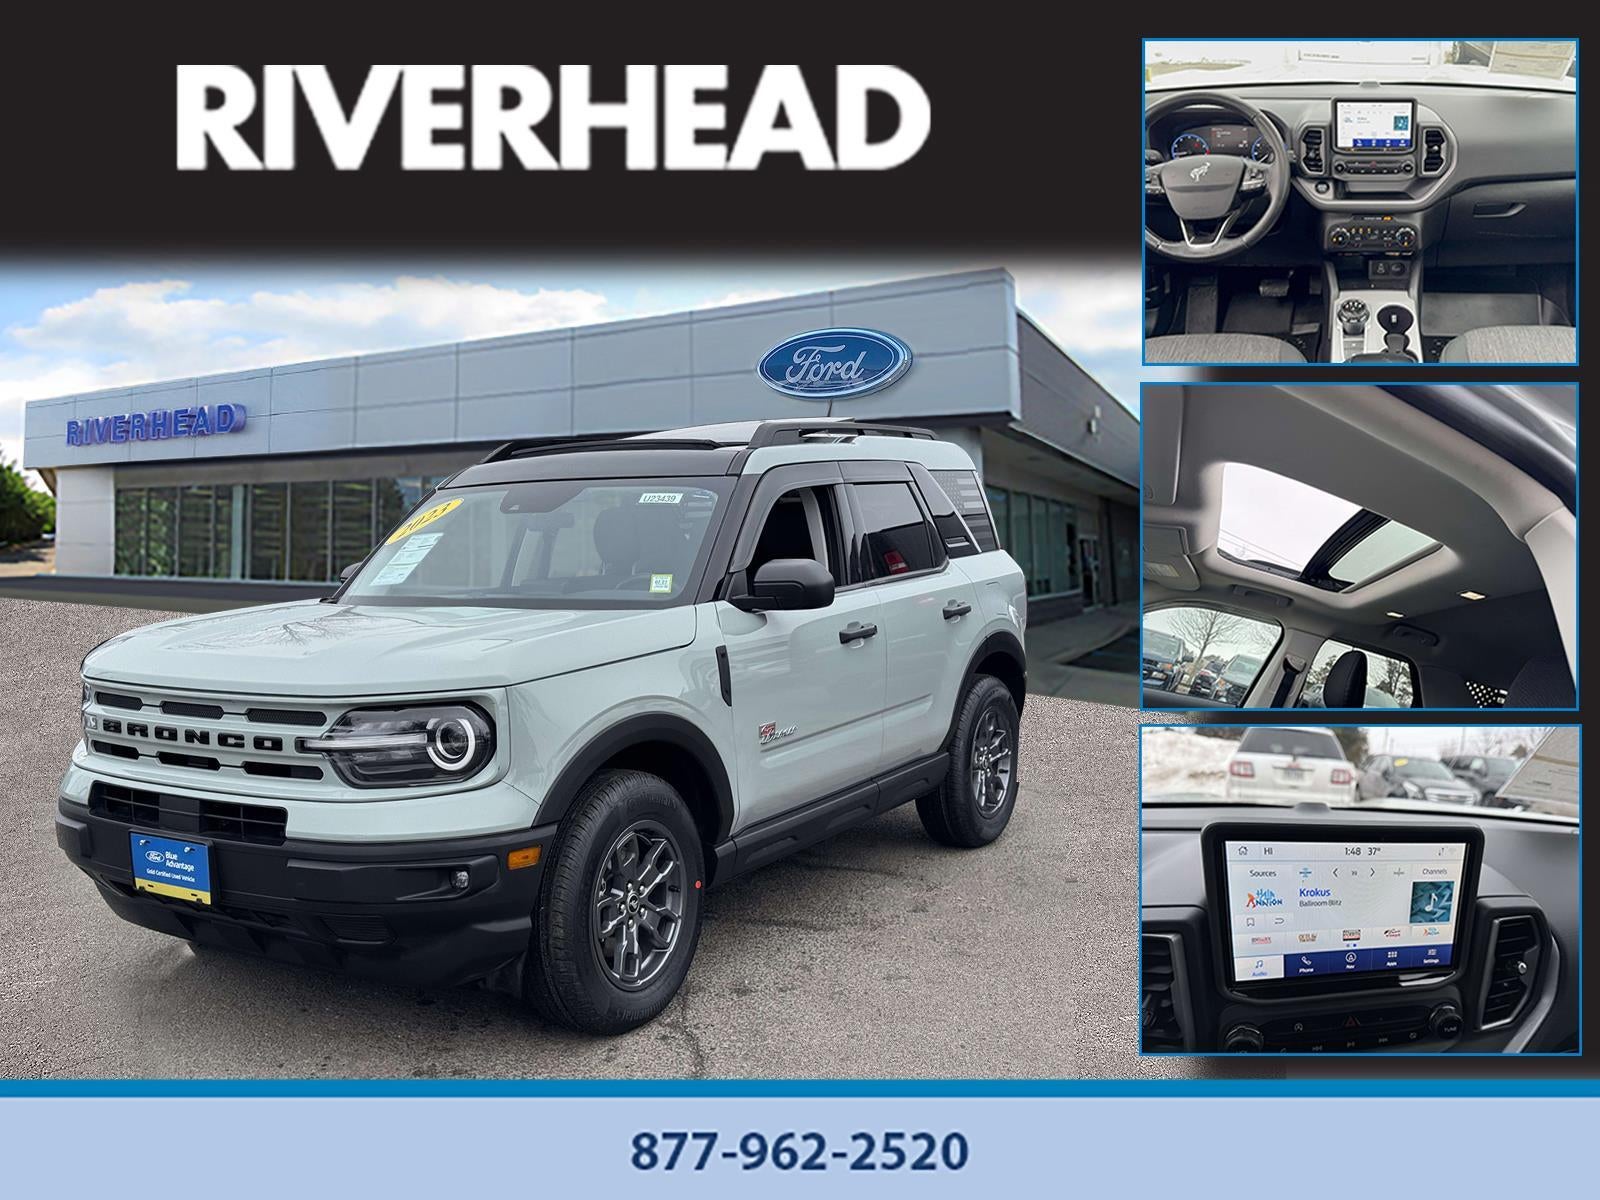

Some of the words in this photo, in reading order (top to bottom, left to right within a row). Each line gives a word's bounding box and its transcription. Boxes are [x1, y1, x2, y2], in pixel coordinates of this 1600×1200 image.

[785, 344, 867, 383] Ford
[66, 403, 246, 446] RIVERHEAD
[103, 718, 283, 752] BRONCO
[165, 851, 178, 861] Blue
[1344, 847, 1362, 856] 1:48
[165, 860, 195, 872] Advantage
[1249, 869, 1277, 878] Sources
[1422, 867, 1448, 876] Channels
[1299, 888, 1332, 897] Krokus
[1299, 900, 1327, 908] Ballroom
[1328, 899, 1342, 907] Blitz
